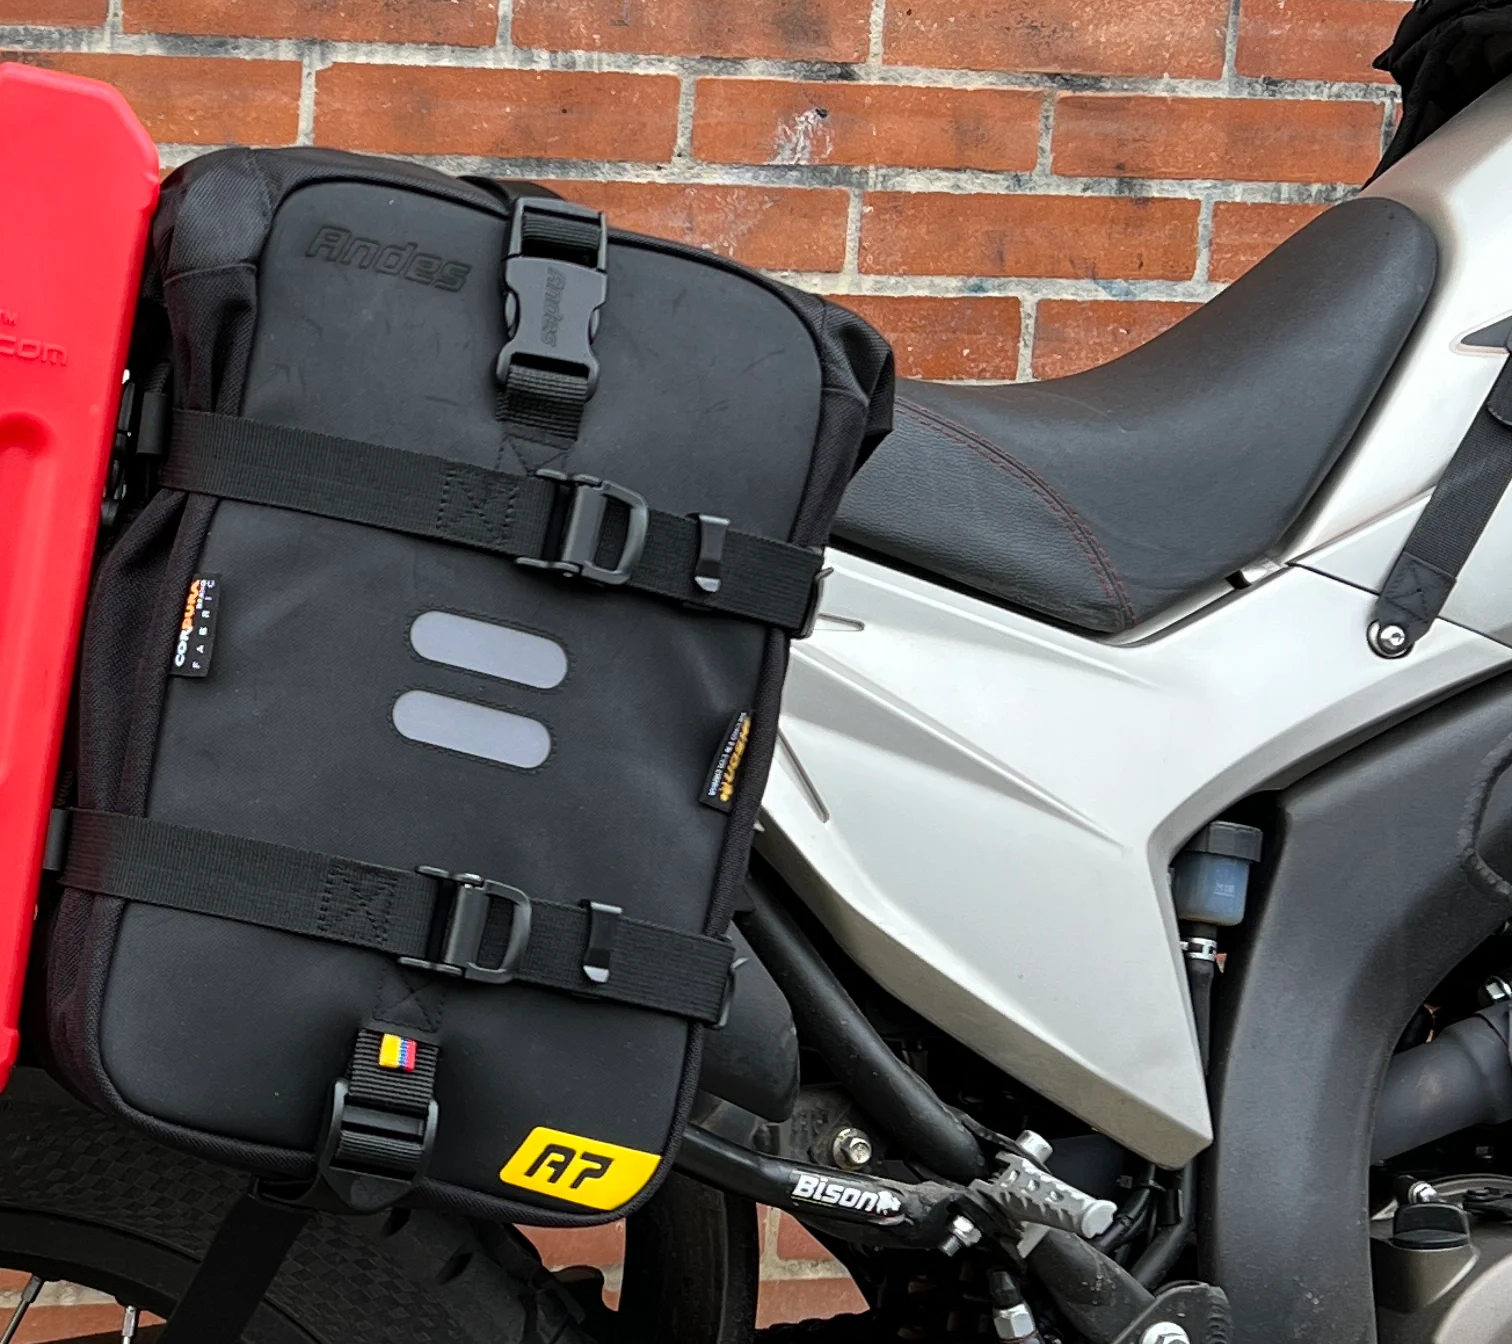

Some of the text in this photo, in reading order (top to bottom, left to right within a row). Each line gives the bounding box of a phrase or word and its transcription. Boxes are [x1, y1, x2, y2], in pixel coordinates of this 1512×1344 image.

[305, 225, 473, 292] Andes
[174, 579, 200, 667] CORDURA
[192, 579, 216, 669] FABRIC
[792, 1173, 880, 1212] Bison
